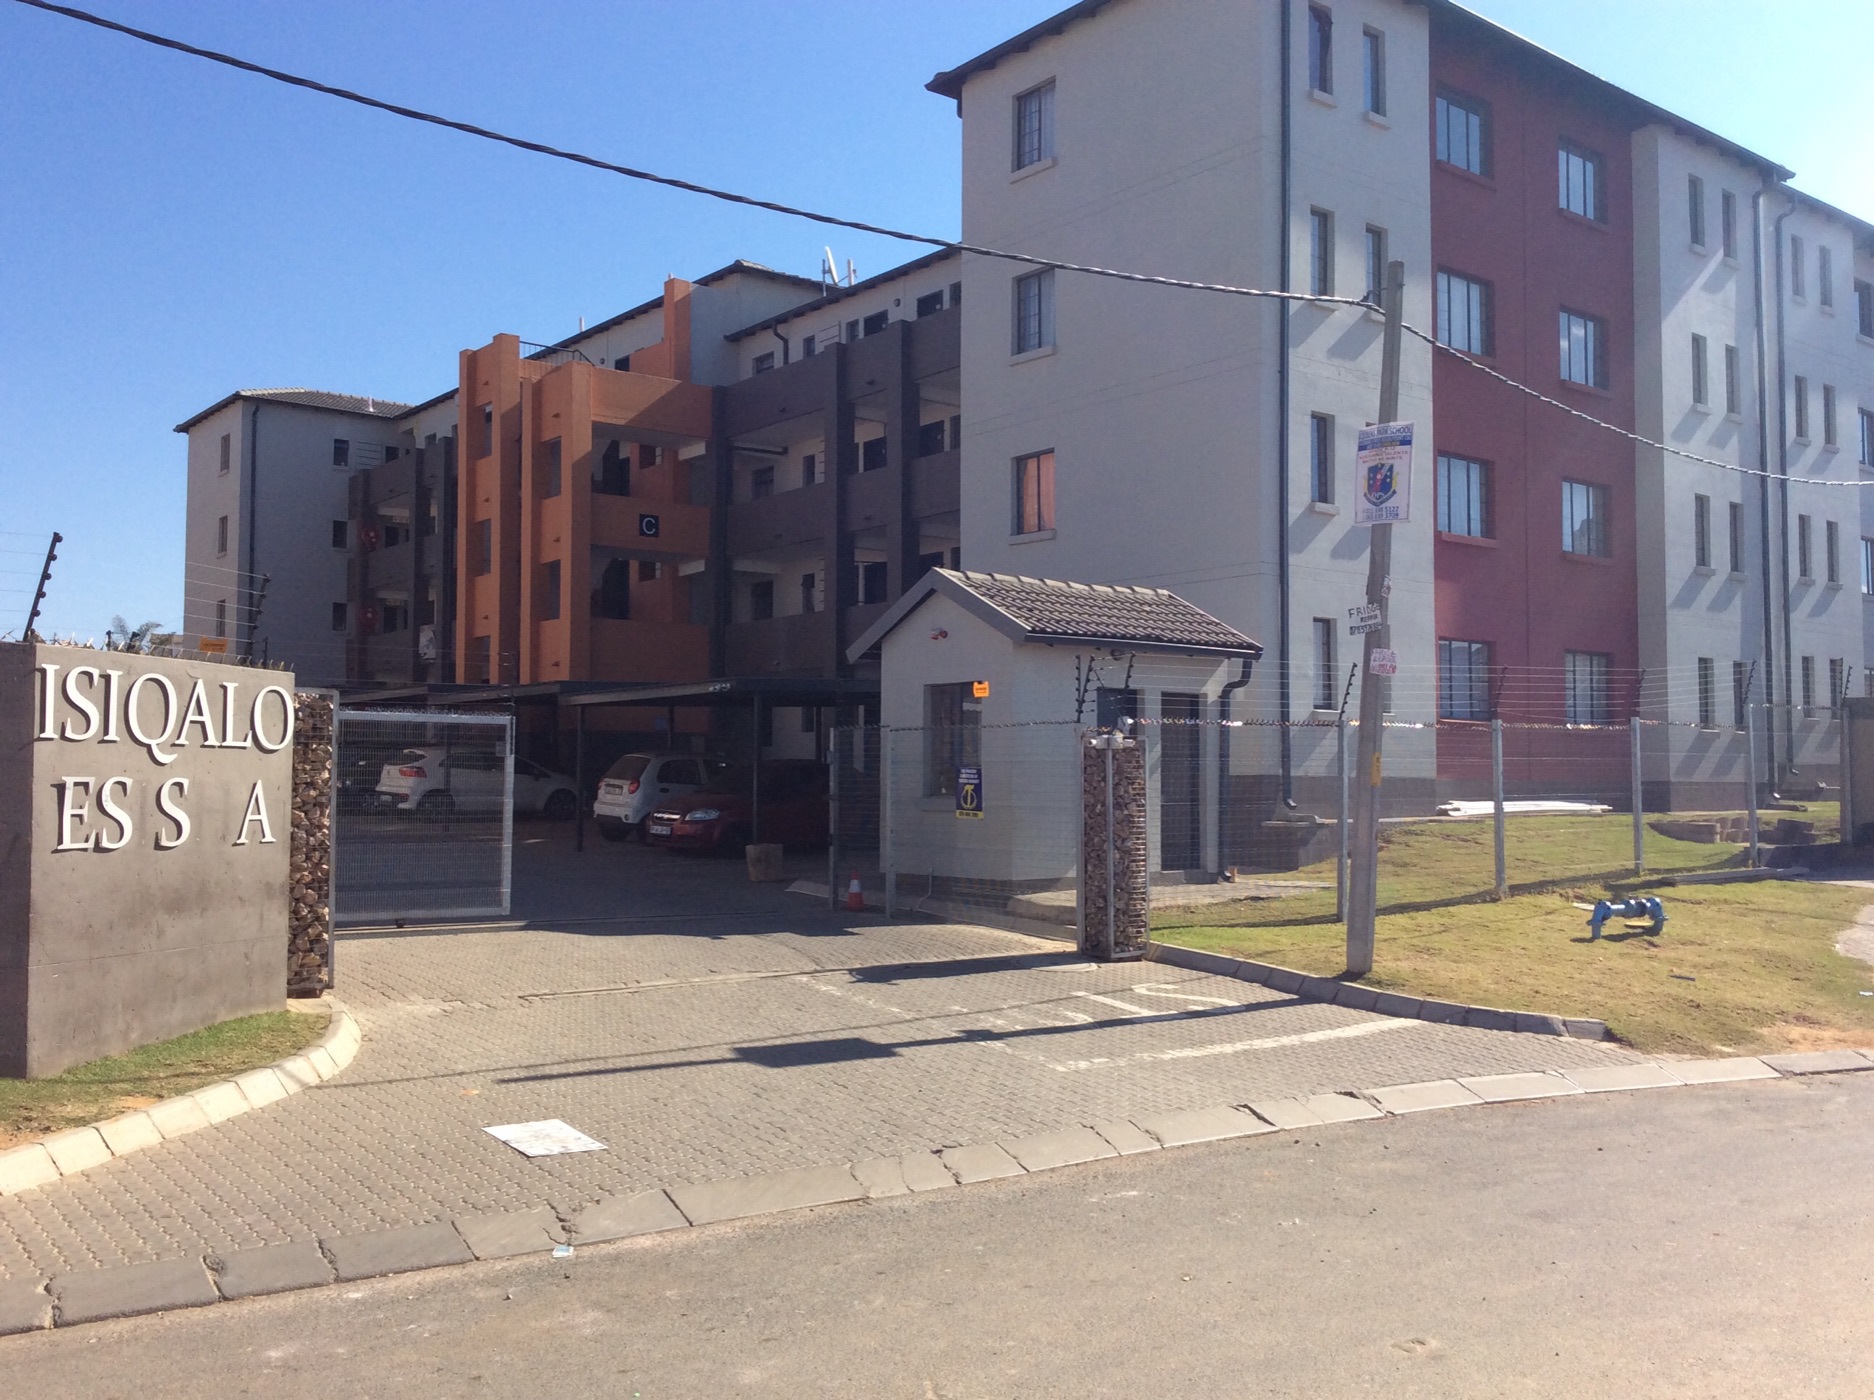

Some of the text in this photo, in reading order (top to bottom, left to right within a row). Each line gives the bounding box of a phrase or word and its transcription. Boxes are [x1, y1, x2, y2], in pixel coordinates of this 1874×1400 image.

[1388, 424, 1412, 435] SCHOOL
[642, 517, 656, 535] C
[1348, 602, 1380, 618] FRIDGE
[39, 663, 295, 764] ISIQALO
